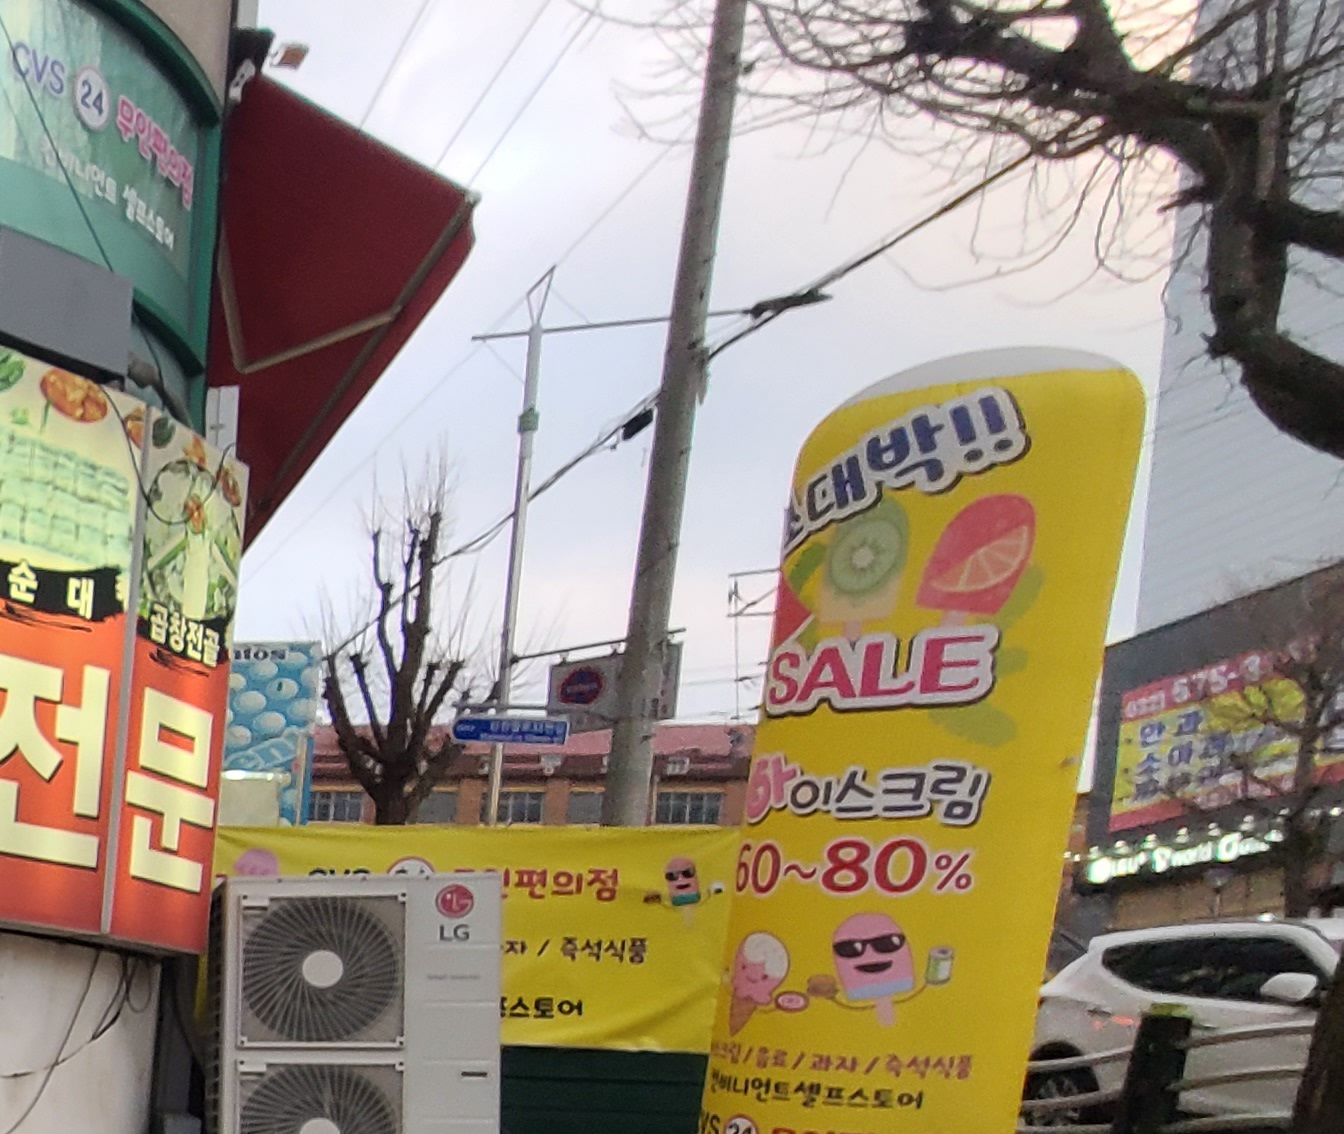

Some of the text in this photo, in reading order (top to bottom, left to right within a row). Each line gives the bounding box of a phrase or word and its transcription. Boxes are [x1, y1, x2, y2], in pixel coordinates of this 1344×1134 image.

[12, 42, 194, 211] CVS 24 무인편의점
[148, 603, 222, 668] 곱창전골
[769, 635, 986, 705] SALE
[454, 867, 620, 902] 편의점
[439, 923, 470, 941] LG
[501, 937, 649, 965] 자 즉석식품
[812, 1051, 858, 1073] 과자
[885, 1053, 973, 1081] 즉석식품
